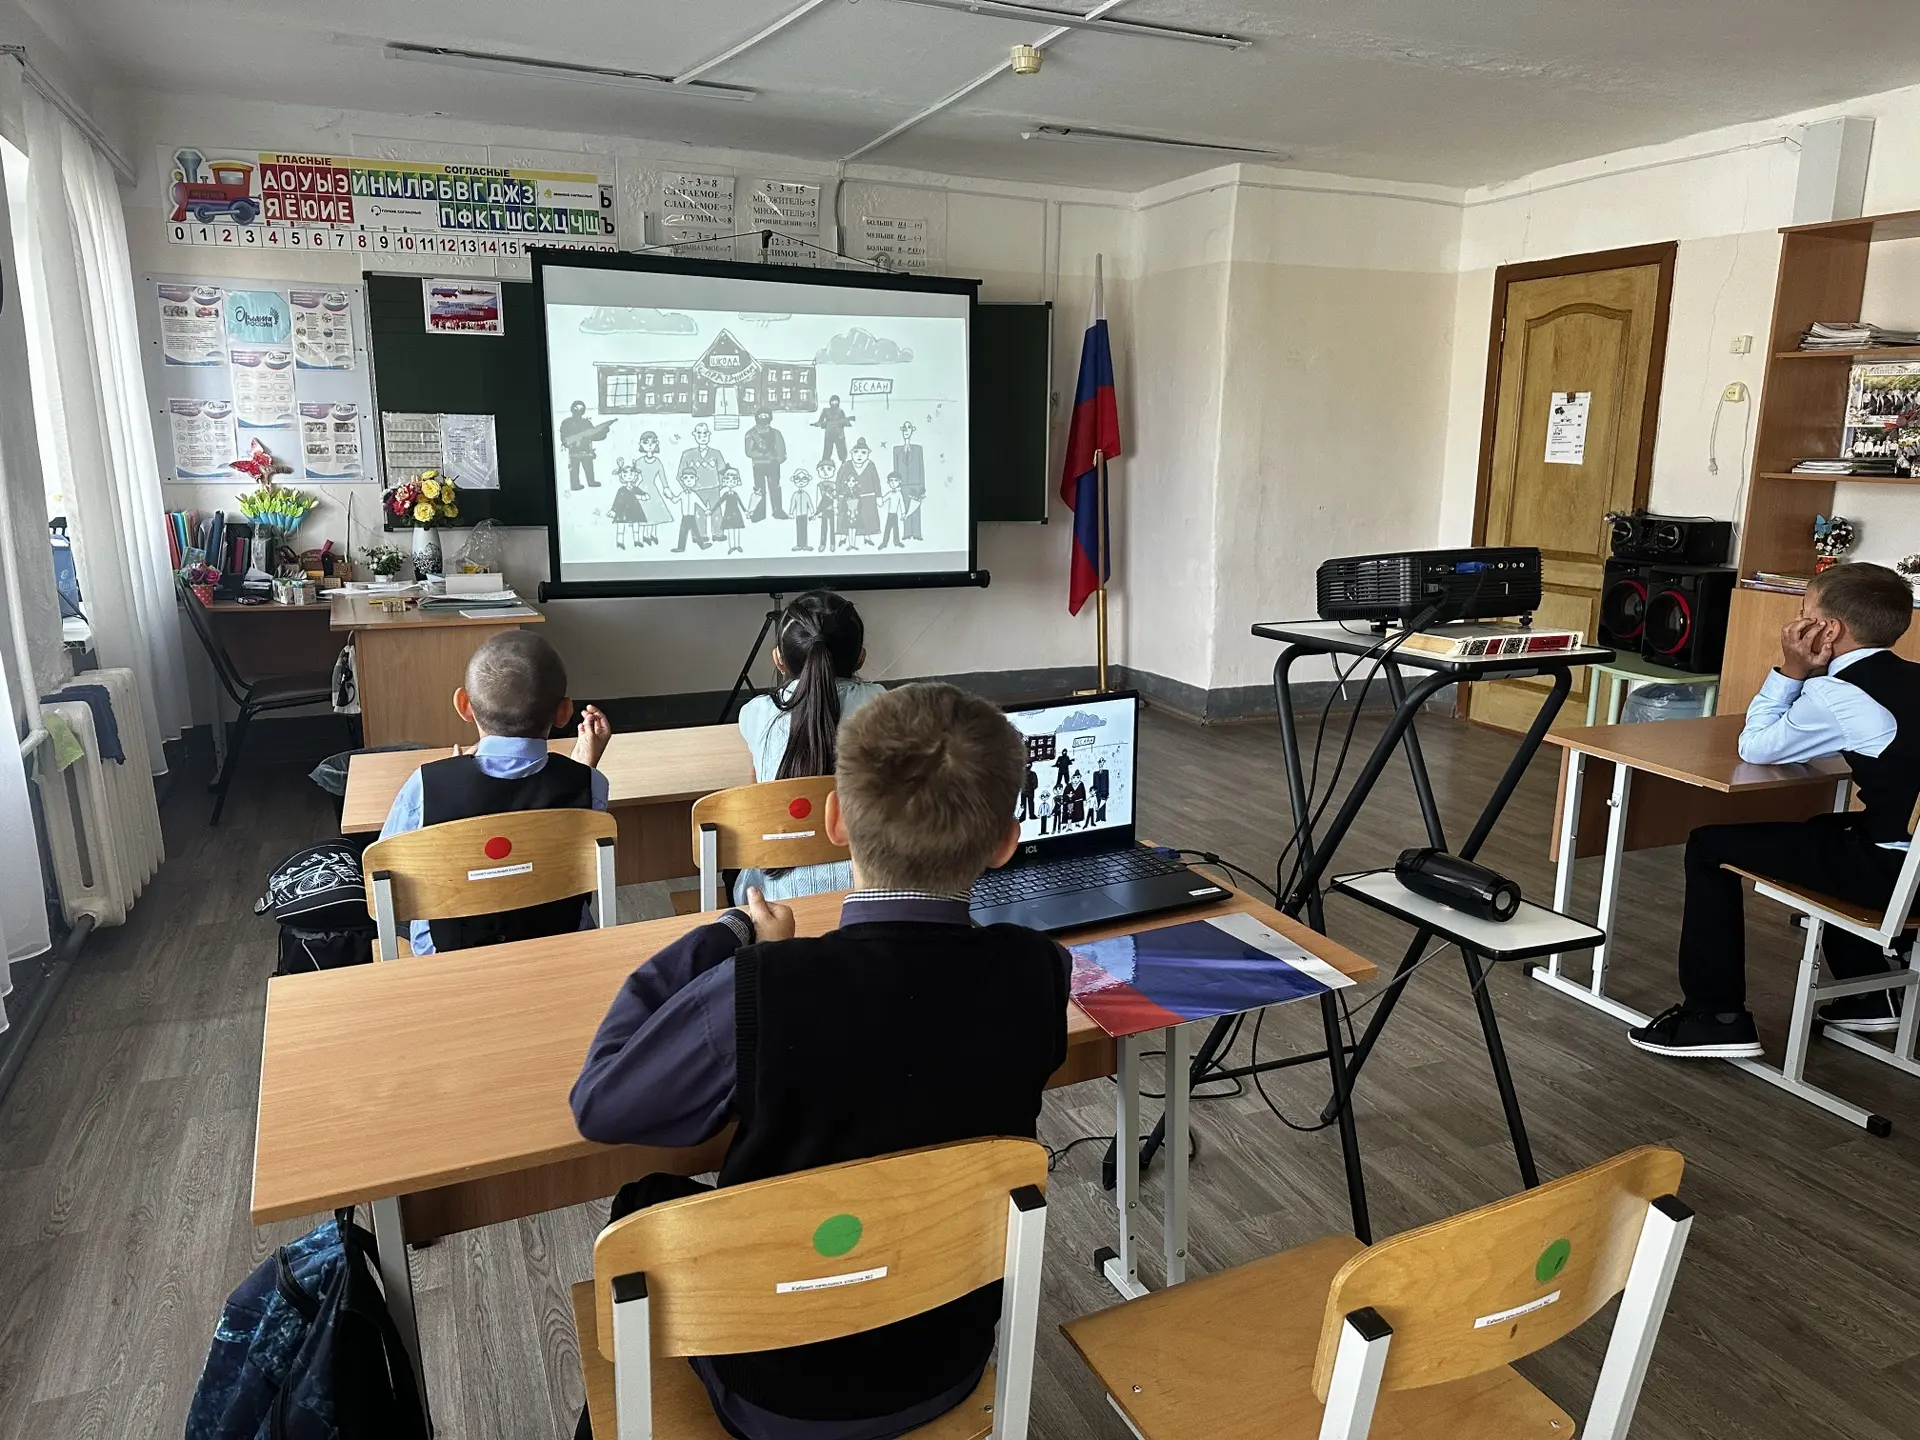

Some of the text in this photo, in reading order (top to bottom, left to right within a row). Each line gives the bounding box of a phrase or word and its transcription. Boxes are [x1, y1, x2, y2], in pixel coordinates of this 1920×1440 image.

[276, 155, 332, 166] ГЛАСНЫЕ
[444, 166, 510, 178] СОГЛАСНЫЕ
[680, 177, 685, 185] 5
[696, 178, 701, 187] 3
[766, 184, 772, 192] 5
[780, 185, 785, 193] 3
[795, 186, 805, 194] 15
[682, 231, 687, 239] 7
[175, 227, 185, 240] 0
[200, 228, 207, 241] 1
[223, 229, 232, 242] 2
[246, 230, 255, 243] 3
[268, 231, 278, 244] 4
[292, 232, 301, 245] 5
[314, 233, 323, 246] 6
[336, 234, 345, 247] 7
[358, 236, 367, 248] 8
[380, 236, 389, 249] 9
[397, 237, 414, 250] 10
[420, 238, 435, 251] 11
[439, 239, 456, 252] 12
[460, 240, 477, 253] 13
[480, 240, 497, 253] 14
[501, 241, 517, 255] 15
[772, 238, 779, 246] 12
[758, 250, 799, 258] ДЛИМОЕ
[854, 381, 889, 392] БЕСЛАН
